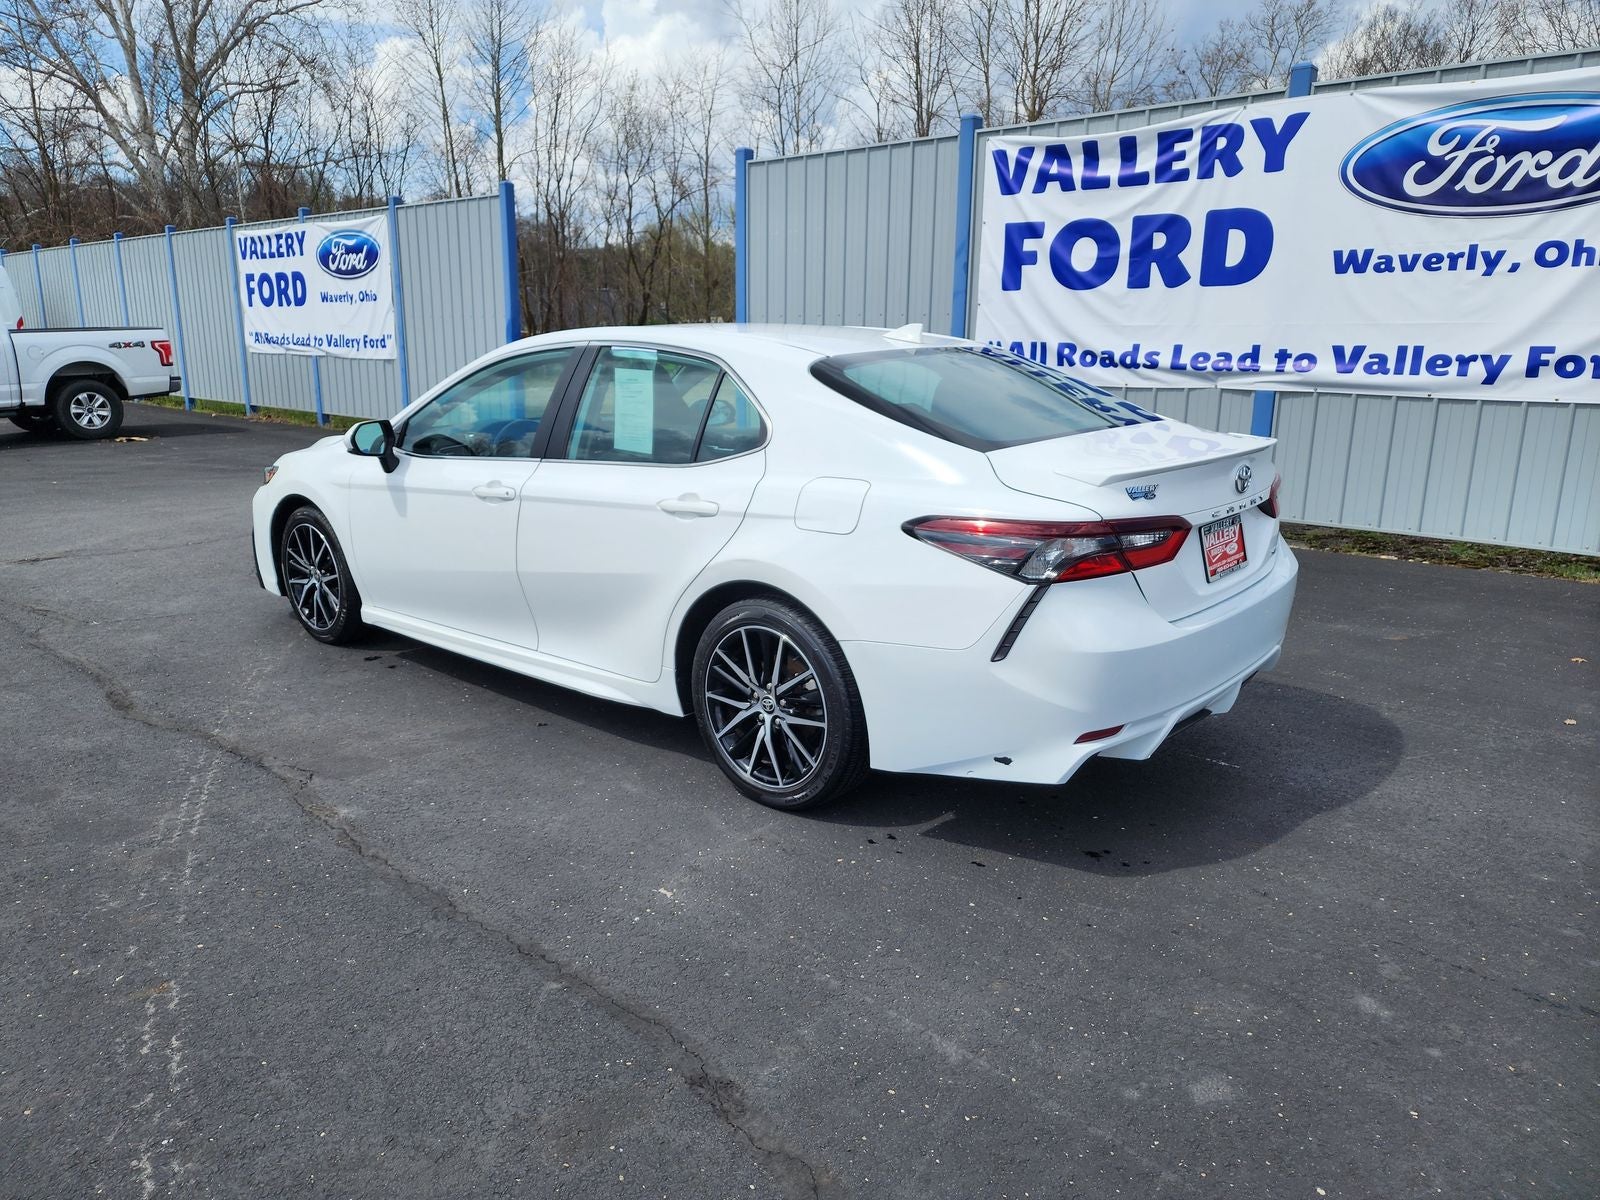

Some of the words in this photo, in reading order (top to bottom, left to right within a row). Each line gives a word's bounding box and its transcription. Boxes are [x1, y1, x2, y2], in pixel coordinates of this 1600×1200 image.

[992, 111, 1310, 196] VALLERY
[1403, 114, 1600, 197] Ford
[238, 230, 306, 260] VALLERY
[328, 238, 368, 271] Ford
[1001, 207, 1274, 291] FORD
[1333, 242, 1521, 277] Waverly,
[1534, 238, 1600, 268] Oh
[245, 271, 307, 308] FORD
[320, 291, 358, 305] Waverly,
[358, 290, 378, 302] Ohio
[291, 333, 311, 347] Lead
[313, 334, 324, 348] to
[325, 334, 361, 352] Vallery
[363, 334, 393, 349] Ford"
[1056, 341, 1160, 372] Roads
[1170, 344, 1262, 373] Lead
[1274, 347, 1318, 374] to
[1331, 345, 1511, 386] Vallery
[1204, 523, 1240, 548] VALLERY
